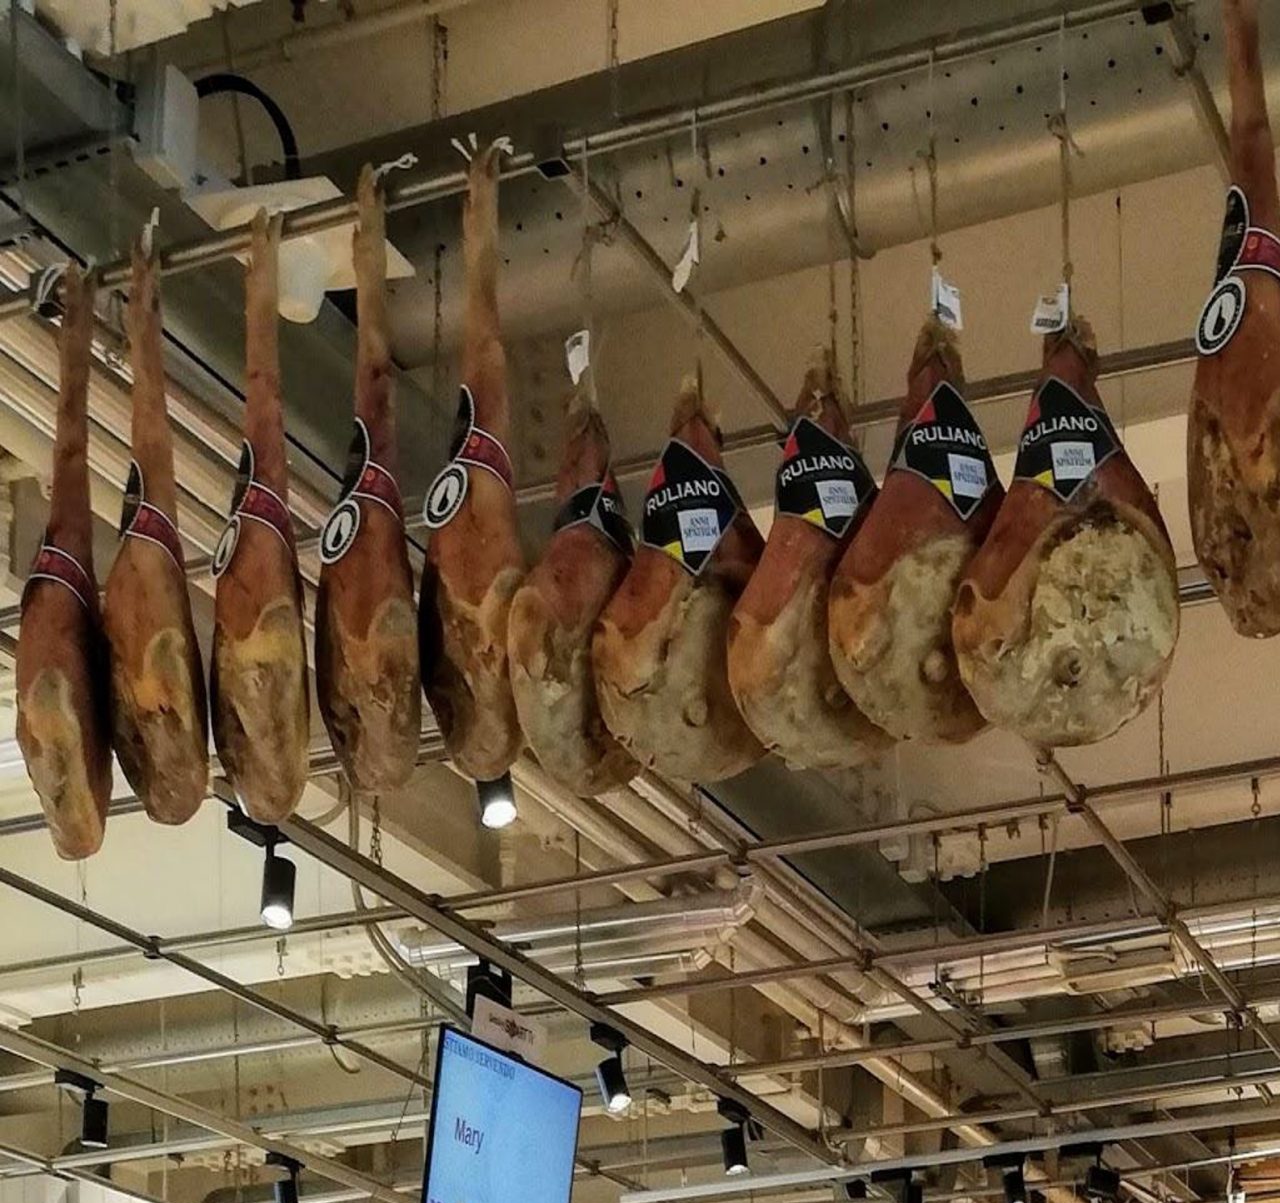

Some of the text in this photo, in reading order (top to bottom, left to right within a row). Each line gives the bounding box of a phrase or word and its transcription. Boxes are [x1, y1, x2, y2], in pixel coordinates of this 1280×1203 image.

[912, 426, 986, 450] RULIANO
[1021, 417, 1097, 452] RULIANO
[780, 455, 854, 487] RULIANO
[646, 480, 720, 515] RULIANO
[455, 1117, 484, 1154] Mary
